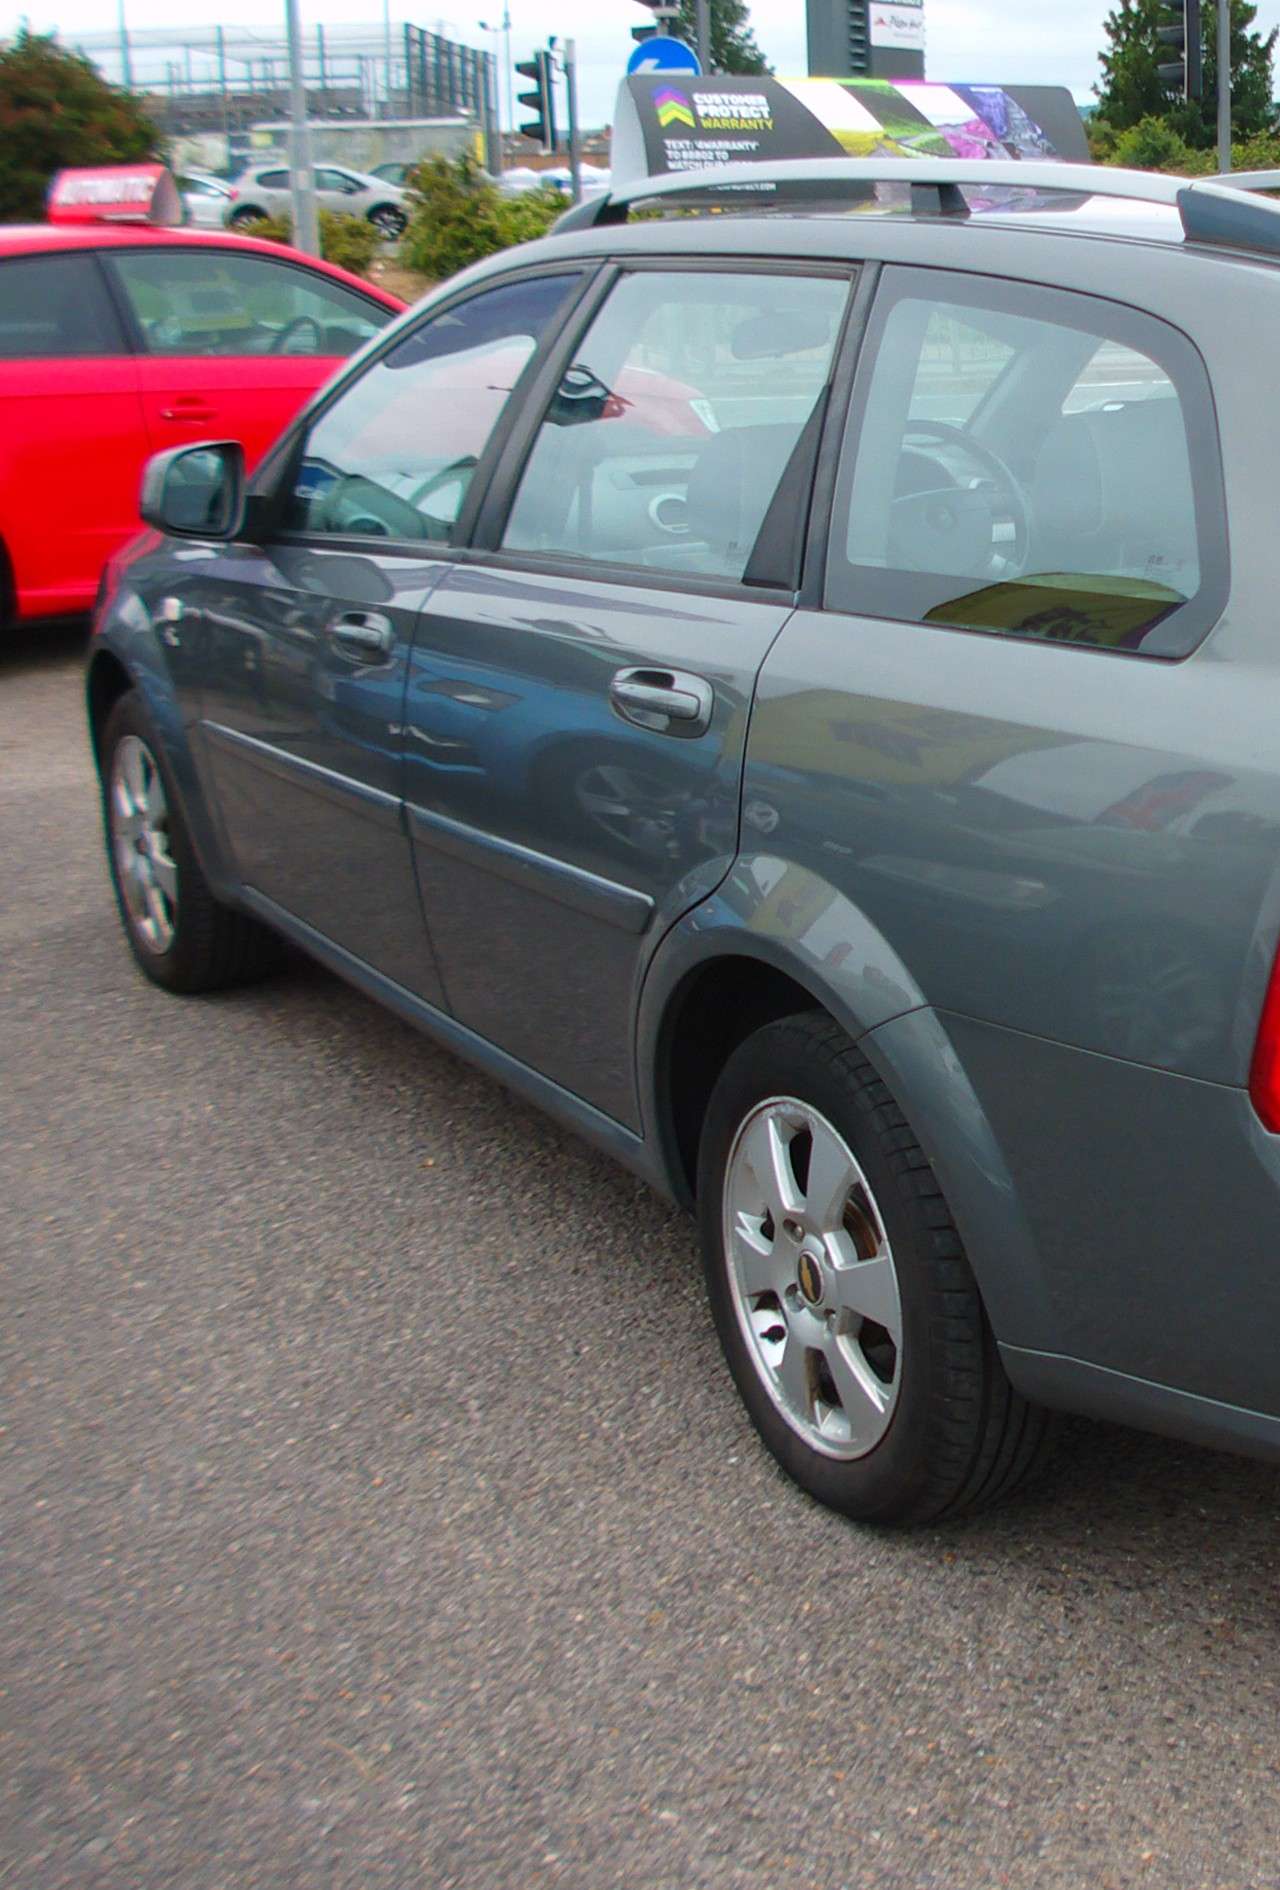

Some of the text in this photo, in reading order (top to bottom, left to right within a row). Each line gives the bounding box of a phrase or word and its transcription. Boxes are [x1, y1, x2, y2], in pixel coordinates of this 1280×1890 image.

[692, 92, 768, 105] CUSTOMER
[696, 105, 771, 118] PROTECT
[700, 117, 773, 130] WARRANTY
